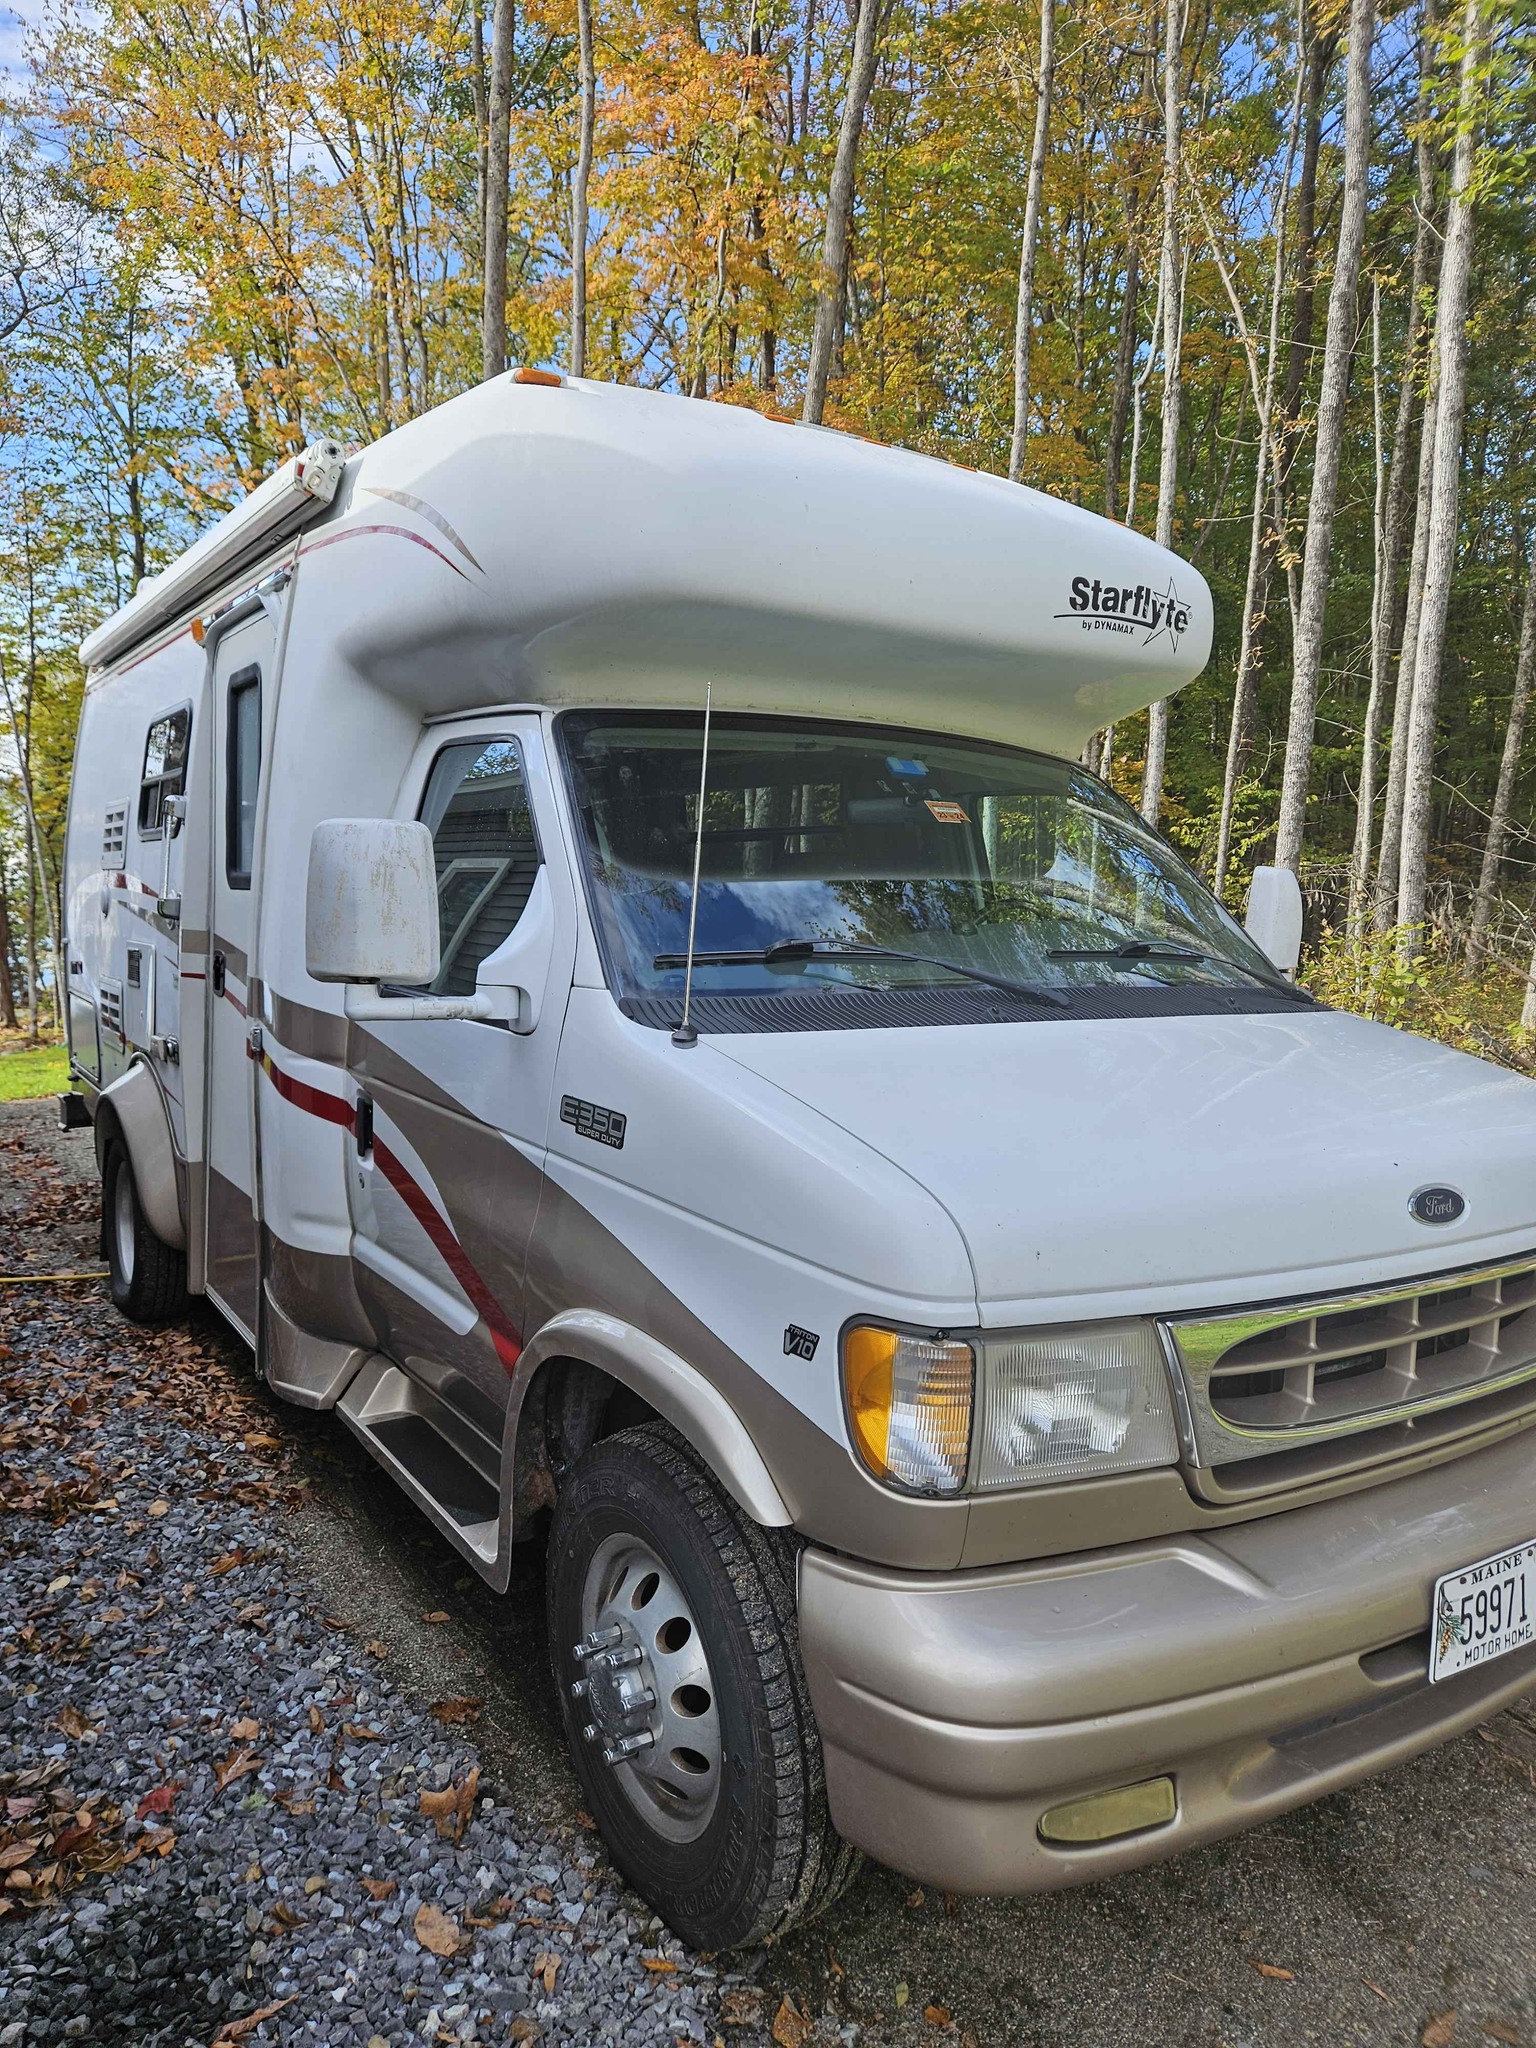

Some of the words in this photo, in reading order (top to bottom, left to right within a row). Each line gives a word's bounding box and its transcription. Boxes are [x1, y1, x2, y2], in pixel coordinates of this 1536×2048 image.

[1068, 576, 1188, 635] Starflyte
[1082, 619, 1092, 631] by
[1094, 620, 1135, 635] DYNAMAX
[577, 1125, 600, 1140] SUPER
[600, 1133, 621, 1147] DUTY
[1425, 1195, 1455, 1217] Ford
[784, 1330, 815, 1359] V10
[790, 1325, 818, 1343] TRITON
[1470, 1552, 1523, 1586] MAINE
[1459, 1572, 1528, 1646] 59971
[1463, 1636, 1501, 1667] MOTOR
[1503, 1622, 1534, 1650] HOME
